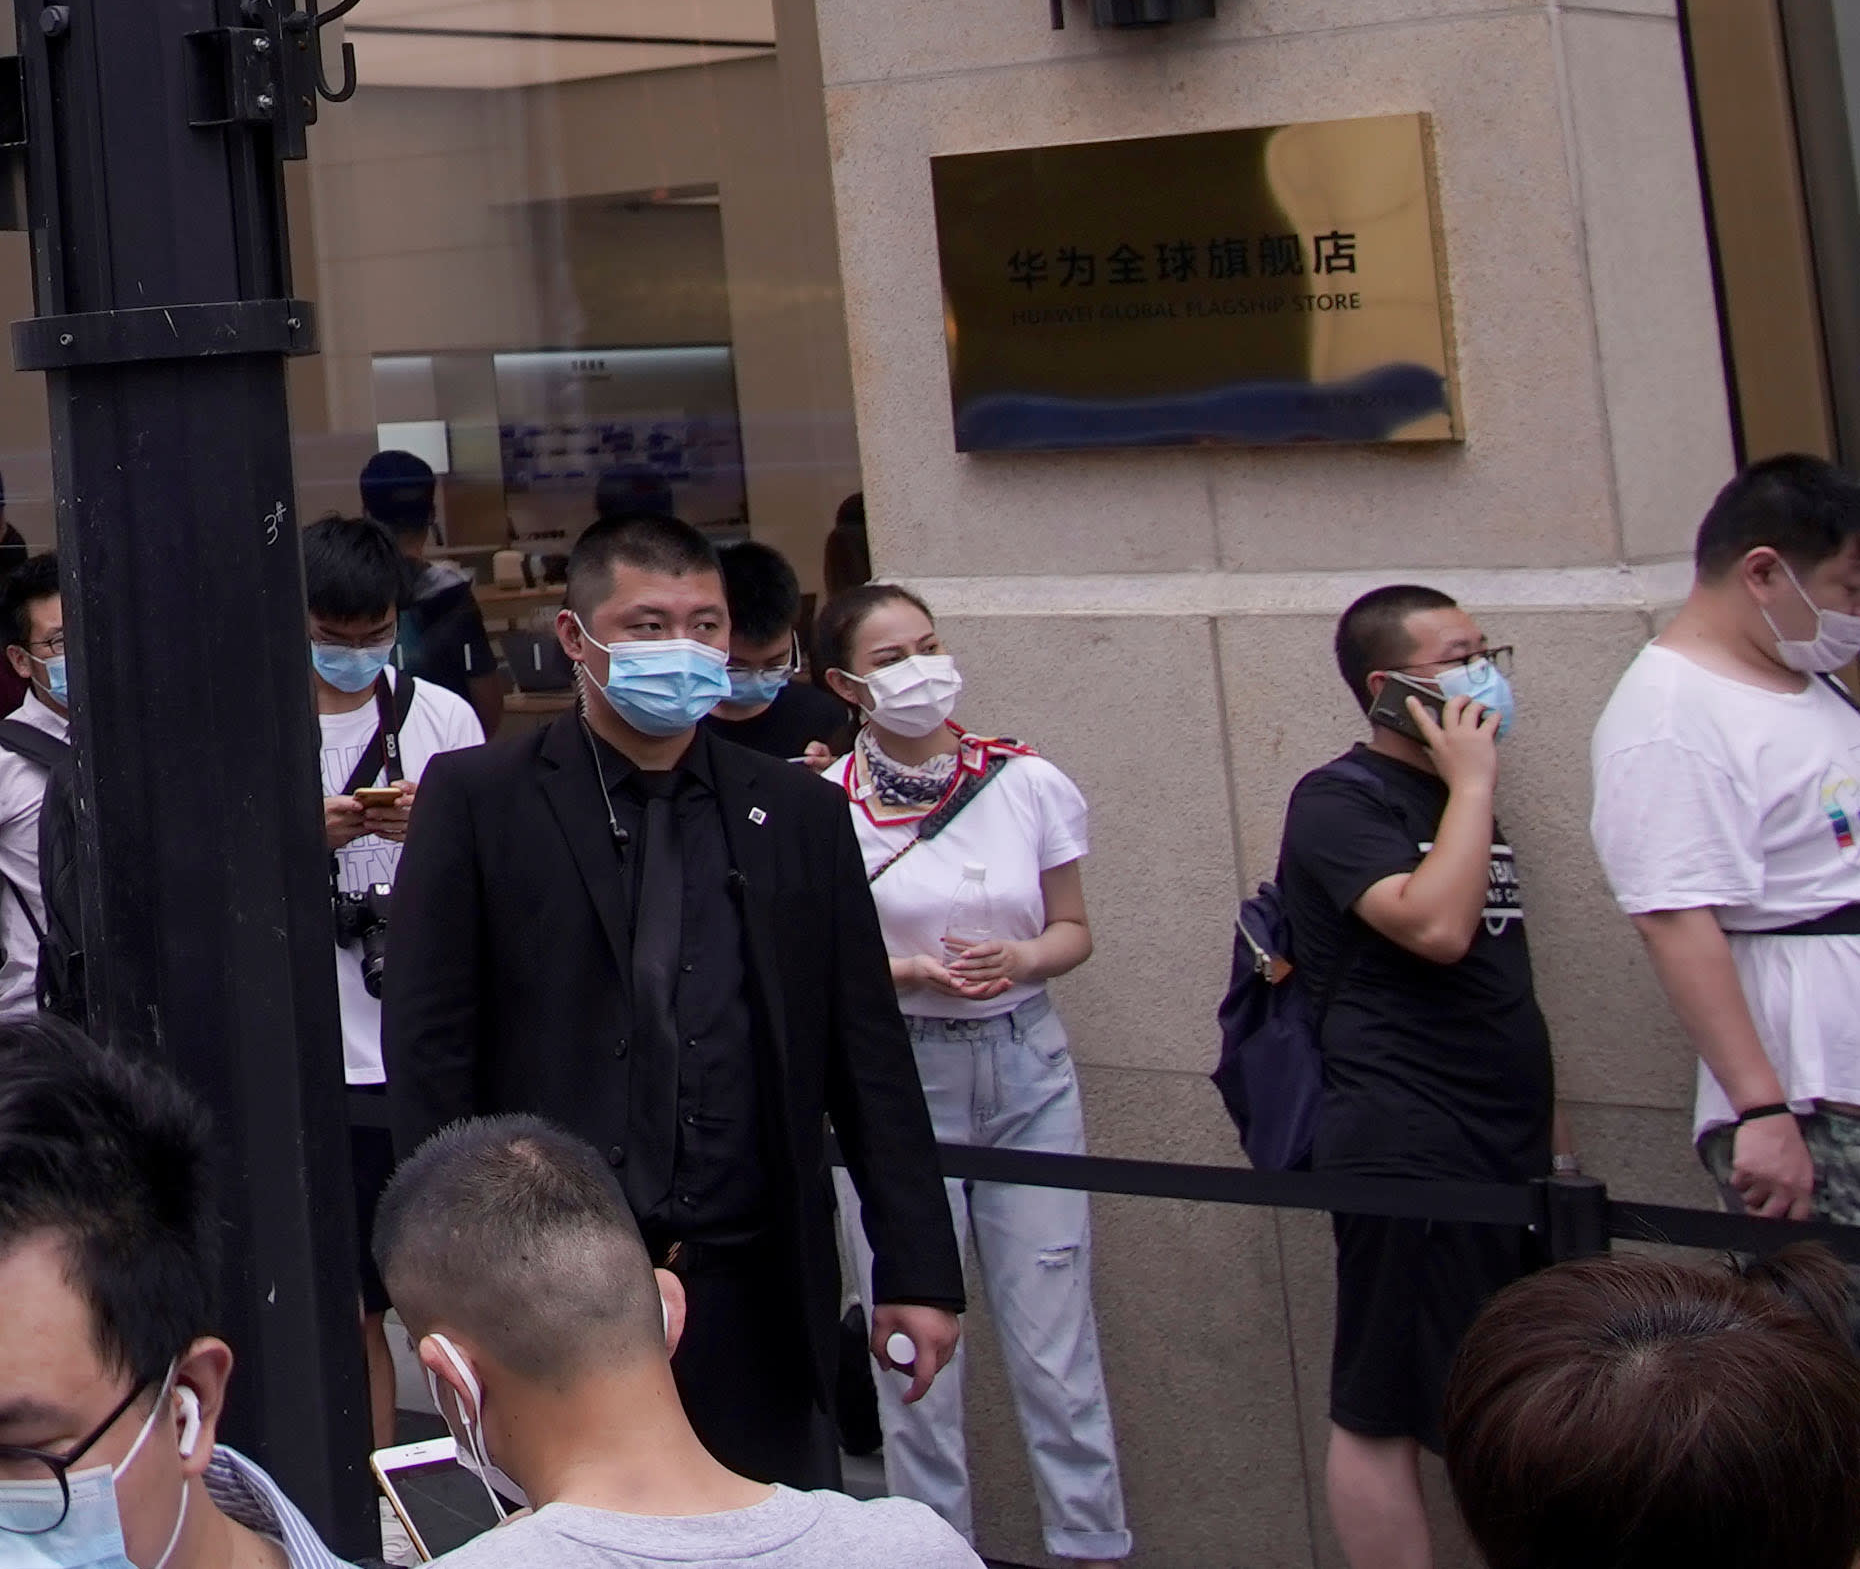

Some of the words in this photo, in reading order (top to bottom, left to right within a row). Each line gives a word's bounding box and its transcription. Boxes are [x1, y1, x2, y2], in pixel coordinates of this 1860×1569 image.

[1006, 230, 1359, 291] 华为全球旗舰店
[1012, 306, 1093, 325] HUAWEI
[1100, 302, 1176, 320] GLOBAL
[1185, 296, 1283, 318] FLAGSHIP
[1292, 293, 1361, 313] STORE
[385, 733, 397, 759] EOS
